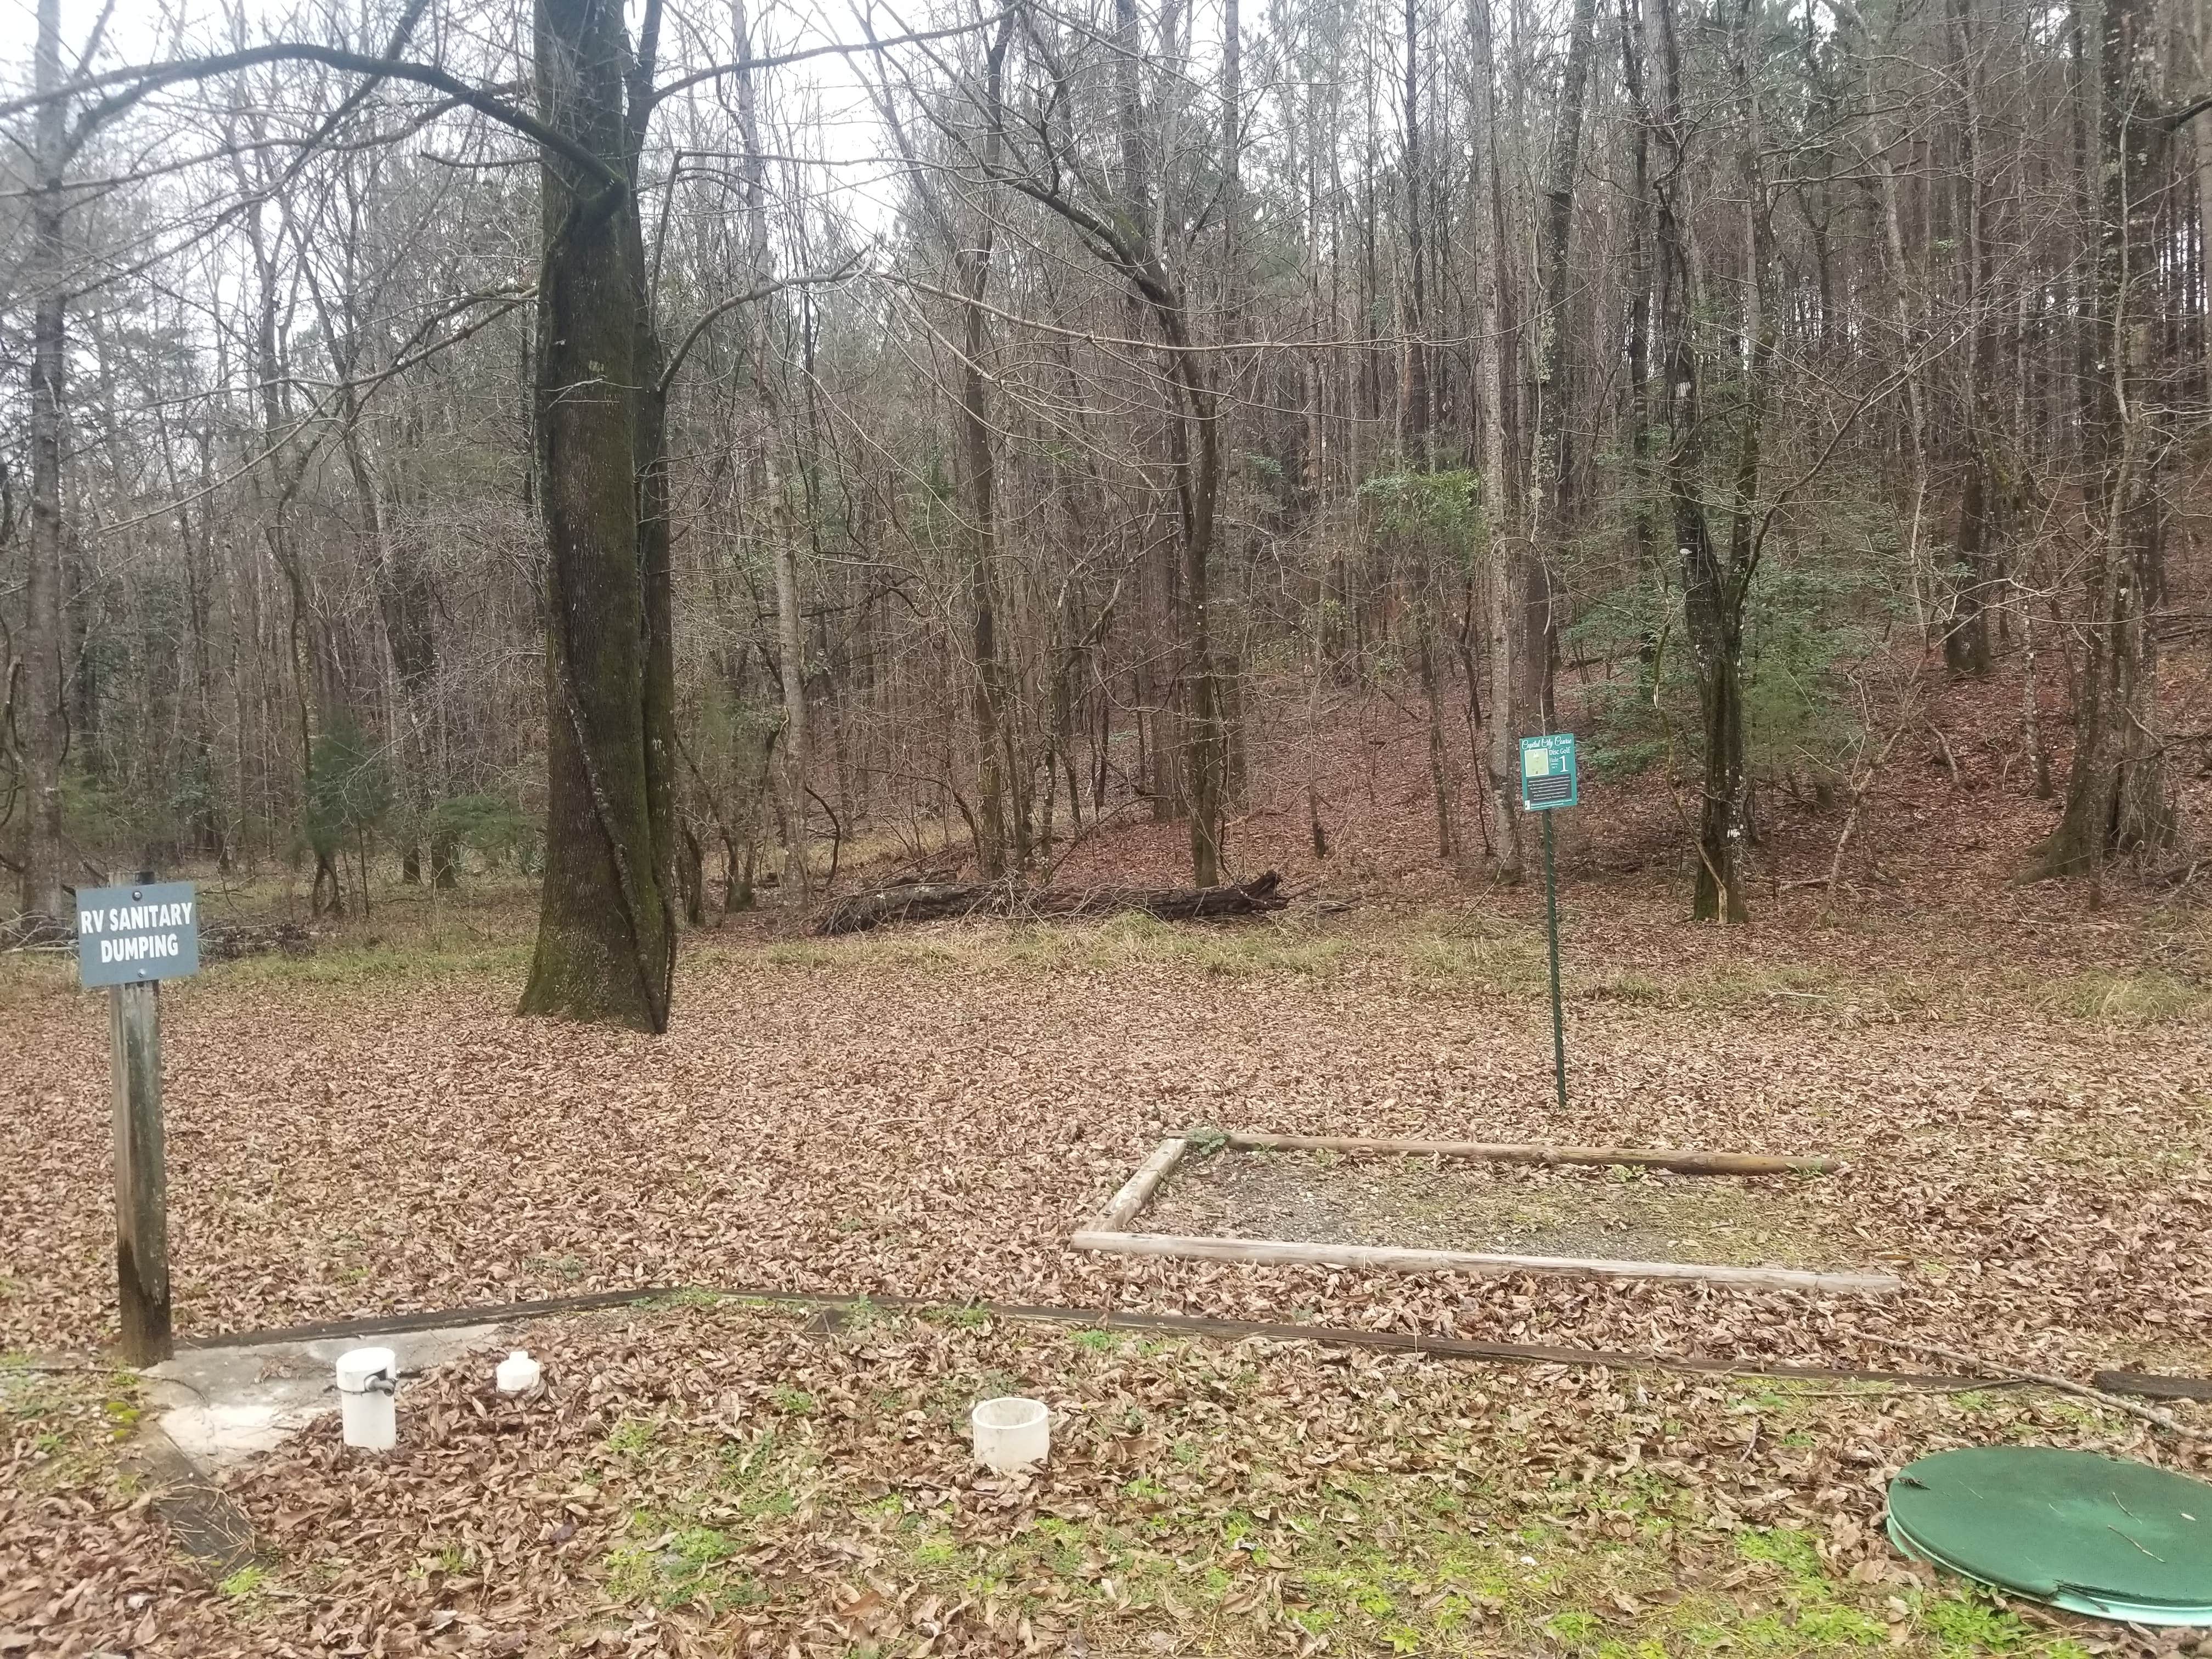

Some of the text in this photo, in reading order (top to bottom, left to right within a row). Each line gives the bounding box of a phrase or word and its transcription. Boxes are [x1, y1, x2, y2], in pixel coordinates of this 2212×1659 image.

[1542, 738, 1553, 749] City
[1554, 736, 1572, 746] Course
[1559, 755, 1568, 772] 1
[81, 902, 192, 934] RV SANITARY
[100, 933, 179, 963] DUMPING
